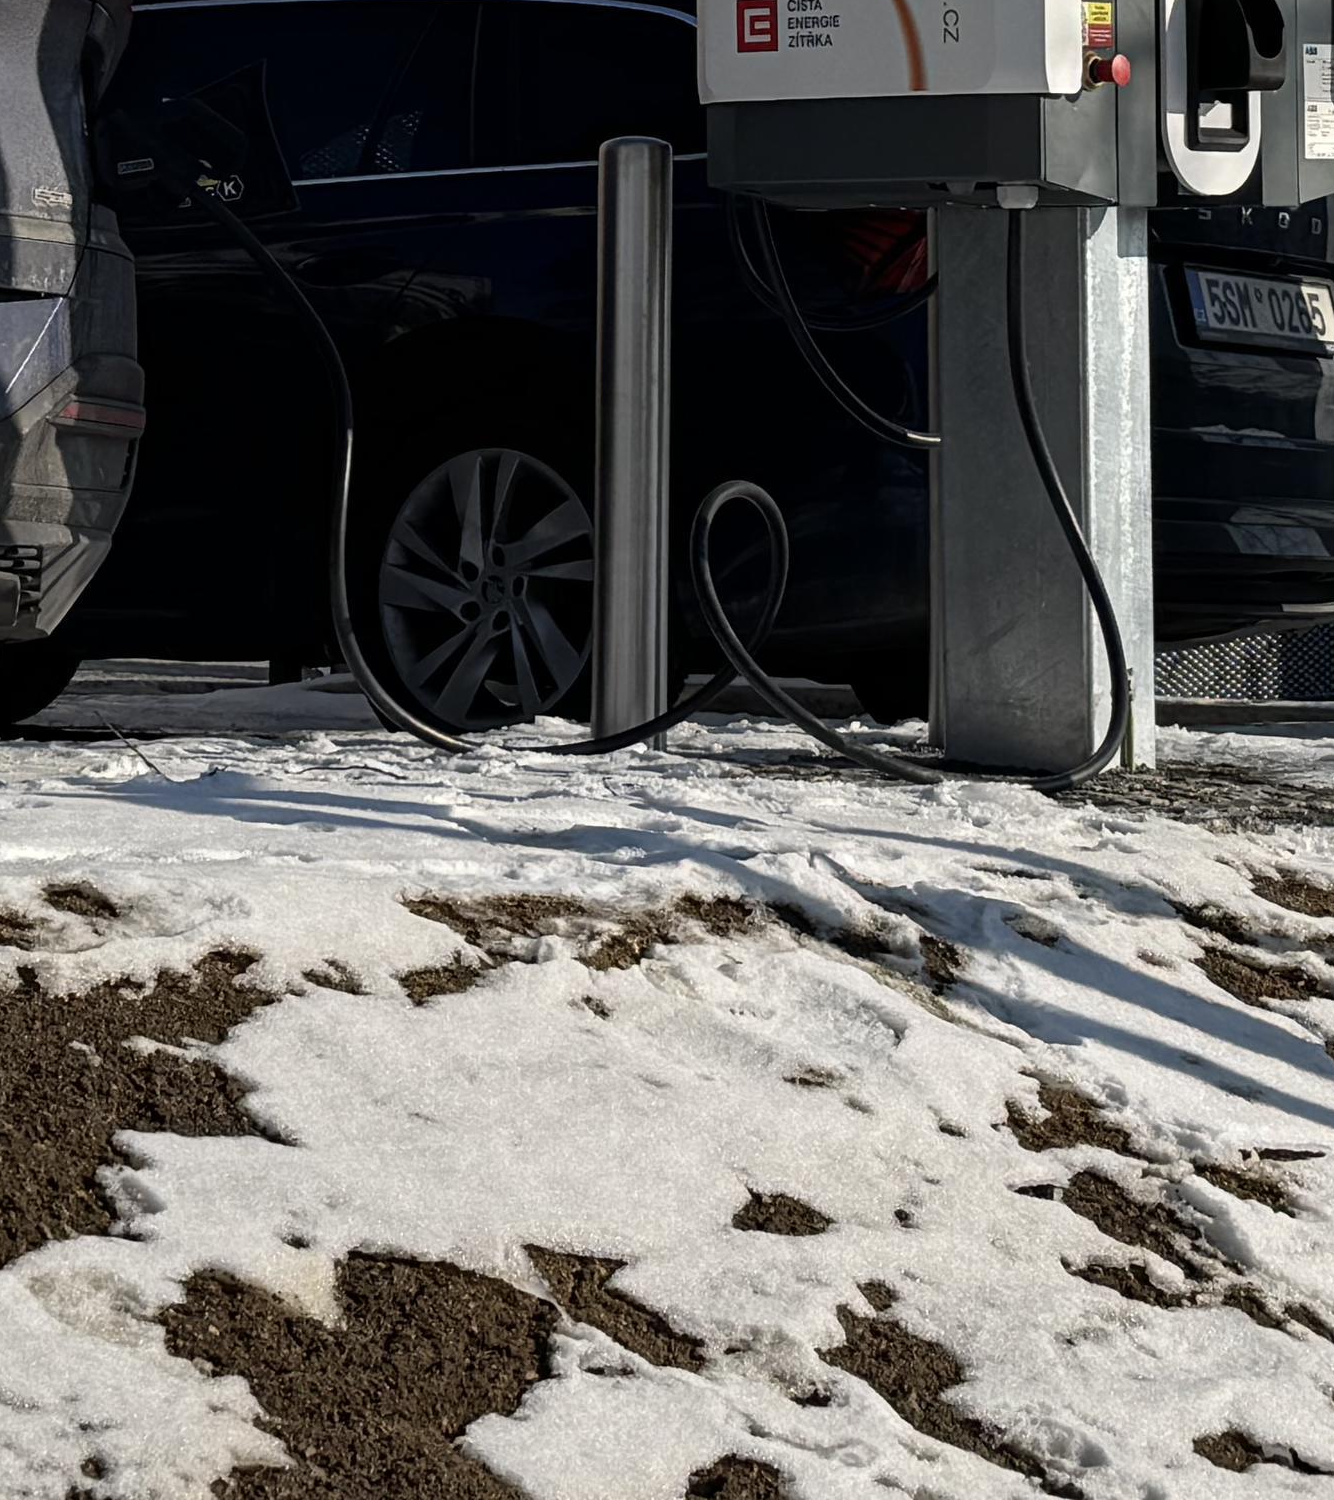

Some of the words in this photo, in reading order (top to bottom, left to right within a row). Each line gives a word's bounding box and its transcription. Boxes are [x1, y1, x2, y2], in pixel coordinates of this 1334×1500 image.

[787, 15, 840, 30] ENERGIE
[788, 31, 833, 48] ZÍTŘKA
[1205, 277, 1257, 329] 5SM
